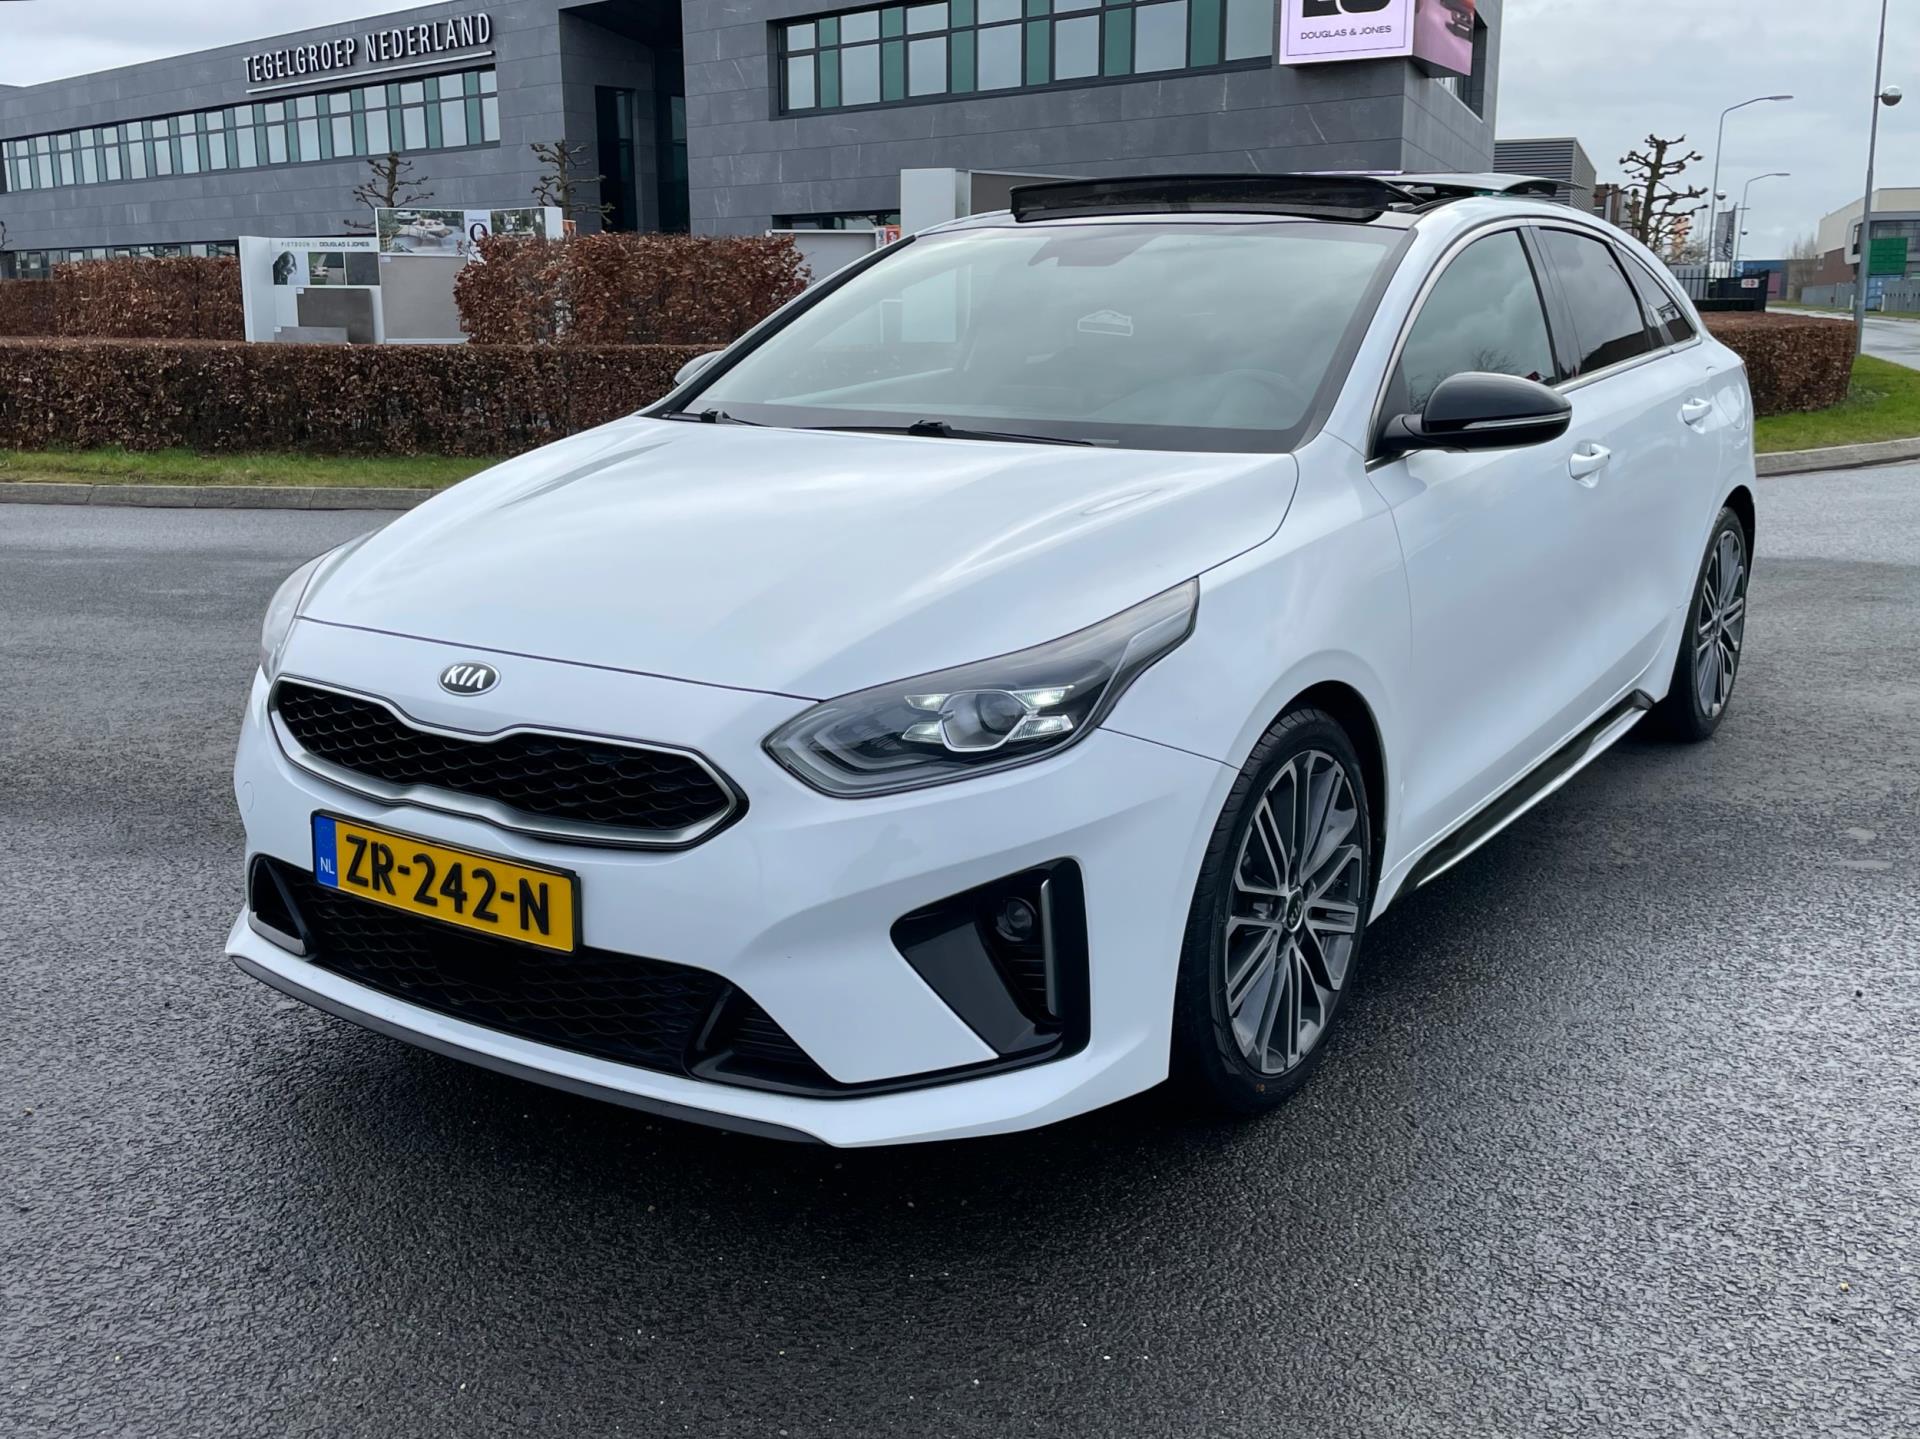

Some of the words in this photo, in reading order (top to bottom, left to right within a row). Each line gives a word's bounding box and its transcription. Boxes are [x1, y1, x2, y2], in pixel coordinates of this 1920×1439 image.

[1300, 29, 1347, 40] DOUGLAS
[1349, 28, 1357, 36] &
[1359, 25, 1392, 36] JONES
[243, 37, 356, 82] TEGELGROEP
[364, 12, 491, 62] NEDERLAND
[443, 665, 488, 689] KIA
[320, 856, 336, 875] NL
[345, 834, 550, 935] ZR-242-N
